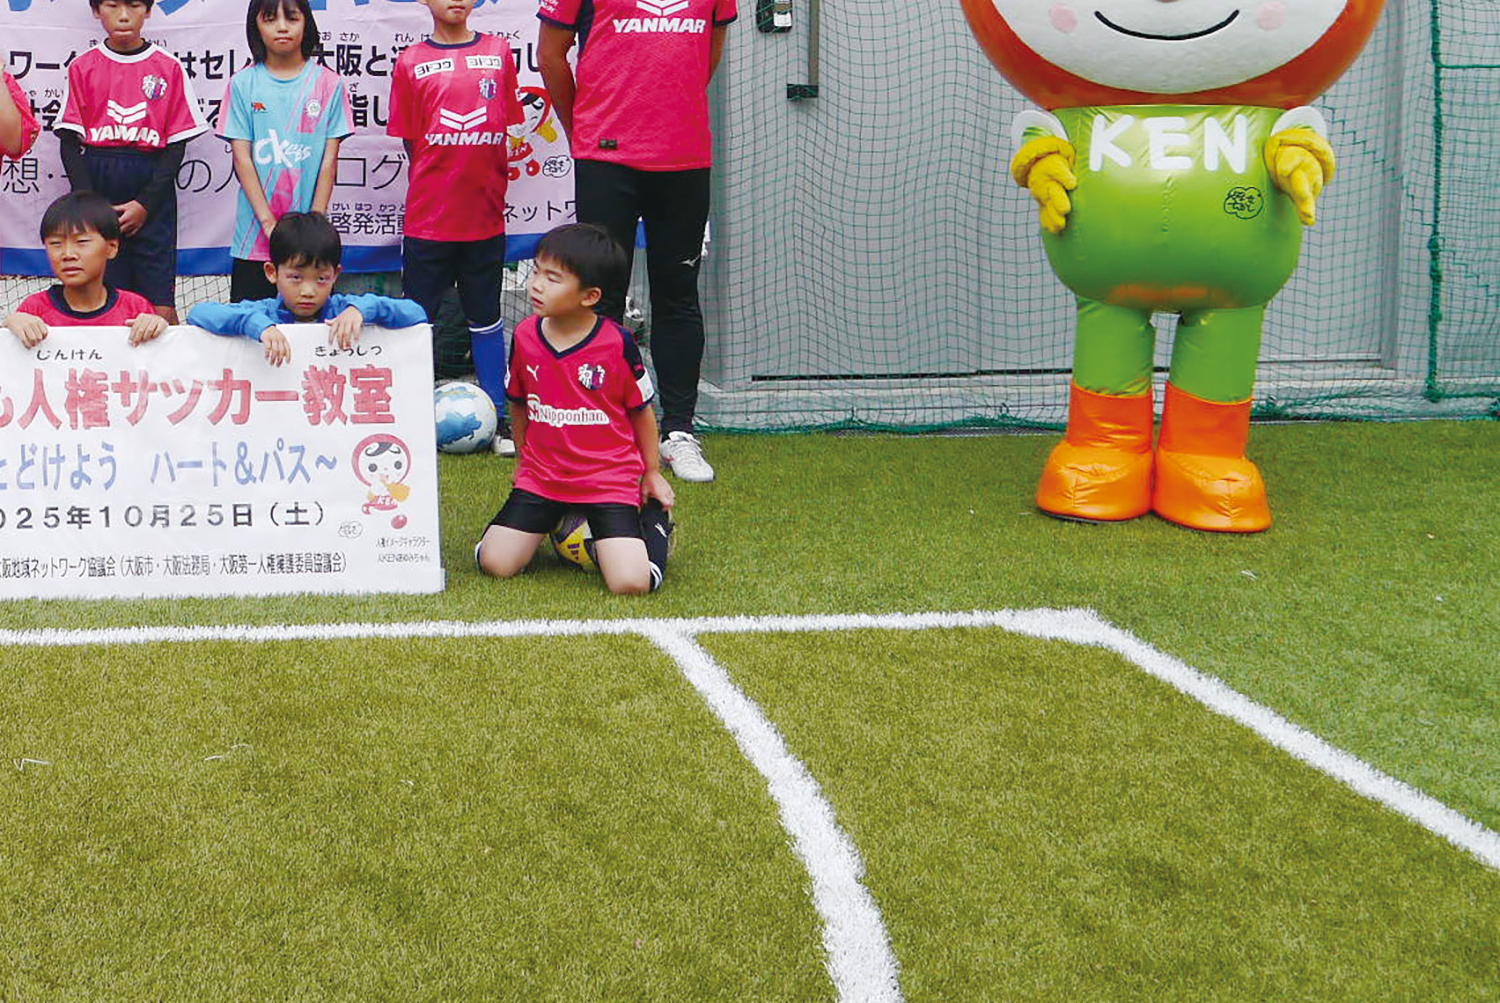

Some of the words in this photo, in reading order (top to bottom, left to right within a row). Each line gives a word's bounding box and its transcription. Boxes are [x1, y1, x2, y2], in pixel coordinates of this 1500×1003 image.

[611, 17, 707, 34] YANMAR
[425, 131, 503, 146] YANMAR
[1088, 114, 1248, 174] KEN
[36, 349, 103, 361] じんけん
